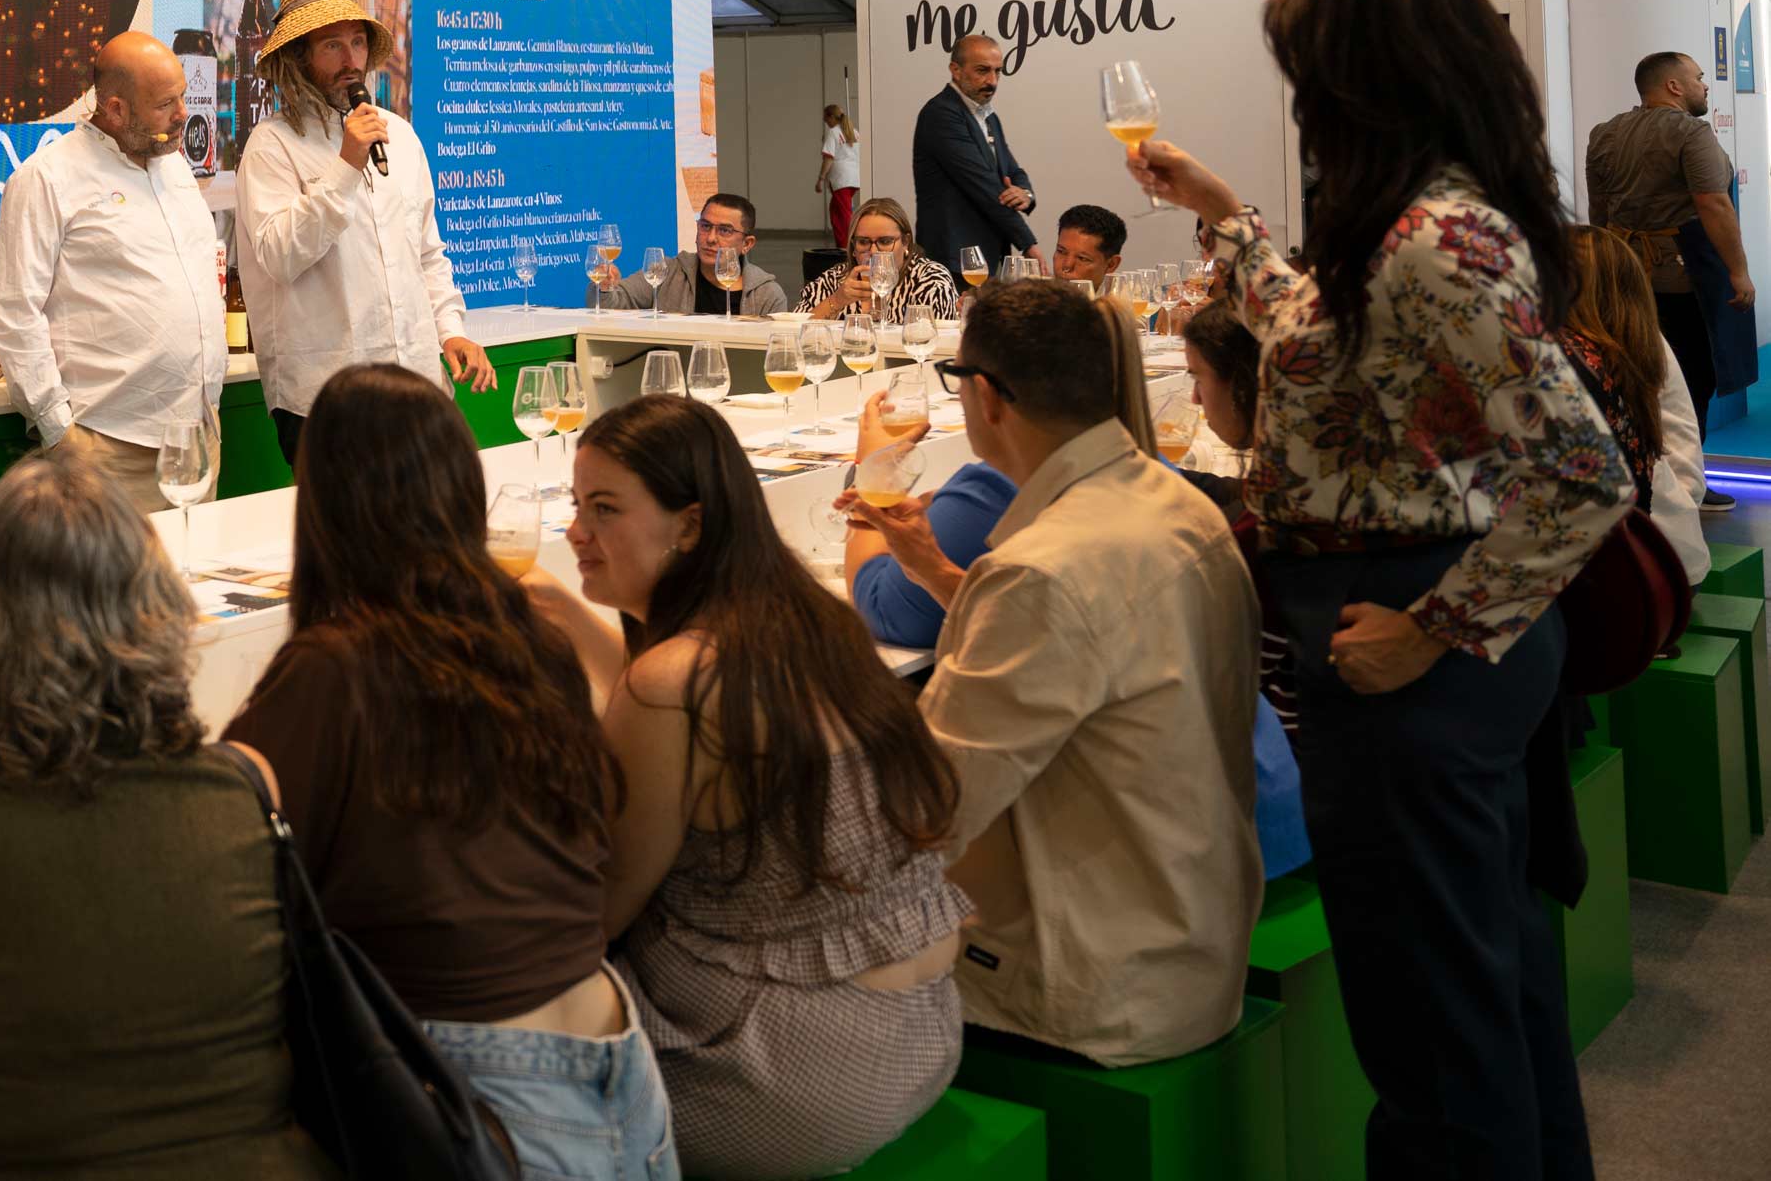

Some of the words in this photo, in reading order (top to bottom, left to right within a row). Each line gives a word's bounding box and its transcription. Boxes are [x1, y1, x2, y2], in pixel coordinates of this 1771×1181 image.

[437, 9, 461, 28] 16:45
[463, 15, 469, 28] a
[471, 10, 493, 29] 17:30
[495, 11, 502, 30] h
[905, 0, 986, 53] me
[438, 141, 466, 159] Bodega
[468, 141, 475, 156] El
[476, 140, 496, 155] Grifo
[438, 170, 464, 190] 18:00
[466, 174, 472, 188] a
[473, 168, 496, 188] 18:45
[498, 168, 505, 187] h
